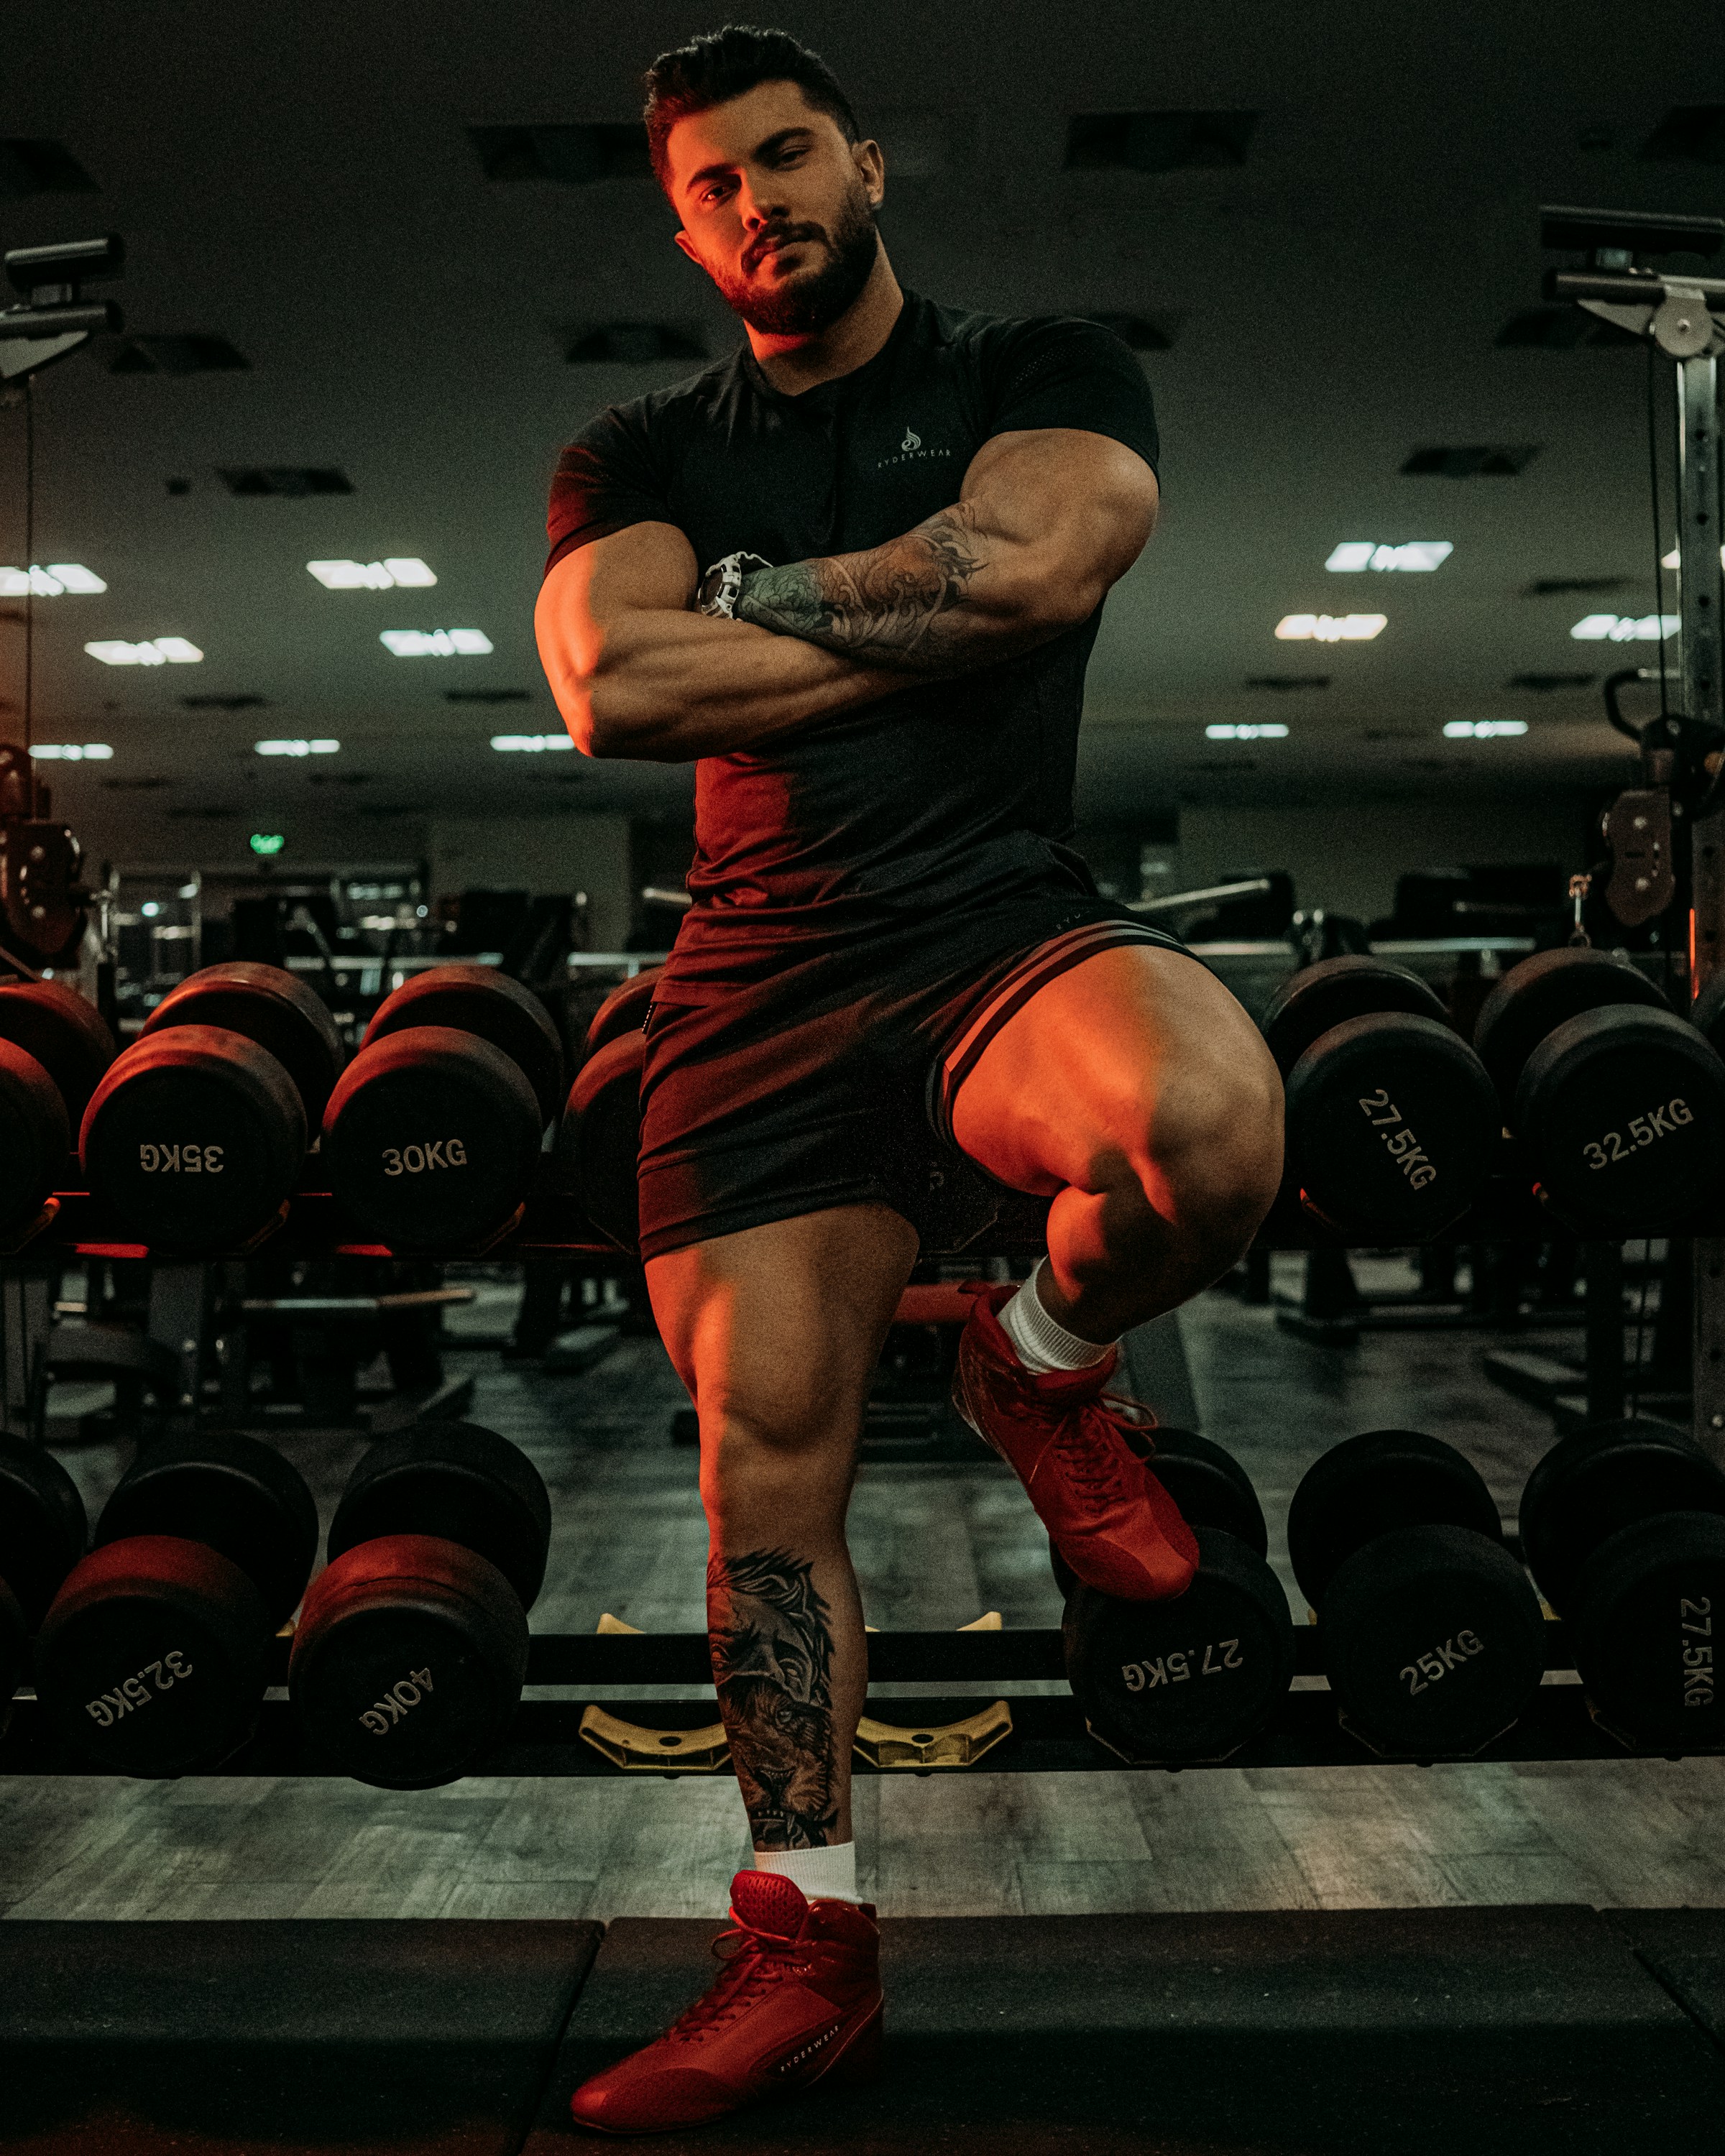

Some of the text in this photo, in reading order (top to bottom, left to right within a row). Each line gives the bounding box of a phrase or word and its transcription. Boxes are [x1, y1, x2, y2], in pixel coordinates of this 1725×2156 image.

[878, 449, 951, 469] RYDERWEAR
[139, 1143, 224, 1174] 35KG
[382, 1138, 467, 1176] 30KG
[1358, 1088, 1437, 1190] 27.5KG
[1583, 1097, 1694, 1170] 32.5KG
[1121, 1638, 1243, 1692] 27.5KG
[1399, 1629, 1484, 1695] 25KG
[1680, 1596, 1714, 1708] 27.5KG
[85, 1650, 193, 1727] 32.5KG
[359, 1667, 433, 1735] 40KG
[781, 2025, 839, 2073] RYDERWEAR
